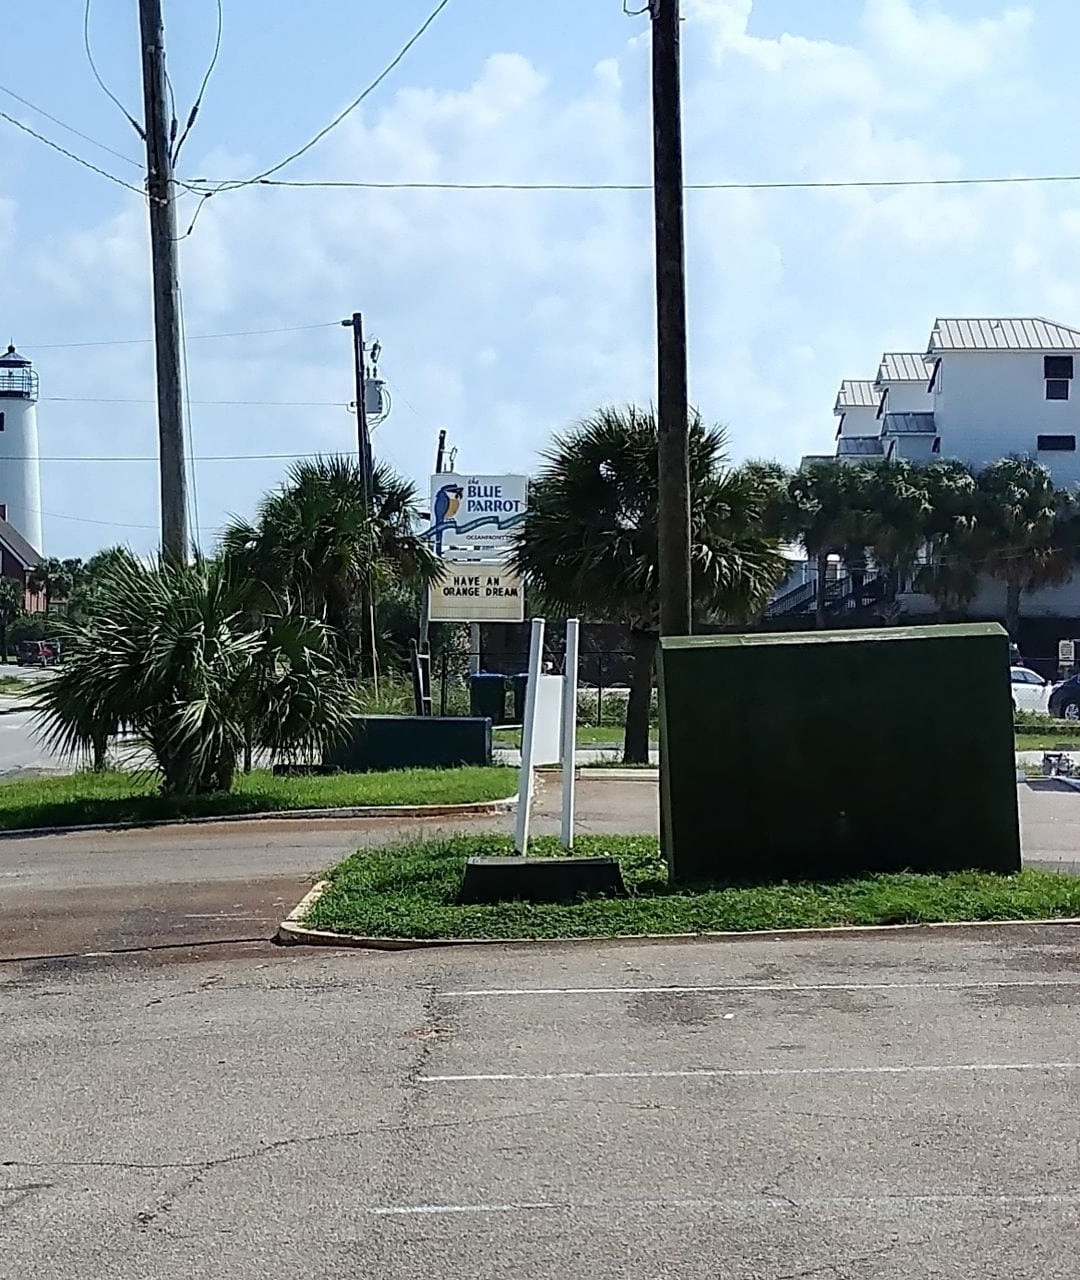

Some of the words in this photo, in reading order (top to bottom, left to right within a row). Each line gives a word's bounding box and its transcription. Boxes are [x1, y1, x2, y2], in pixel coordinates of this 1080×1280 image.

[468, 486, 502, 498] BLUE
[468, 500, 520, 512] PARROT
[454, 576, 480, 586] HAVE
[486, 576, 500, 586] AN
[442, 588, 480, 596] ORANGE
[486, 588, 518, 596] DREAM
